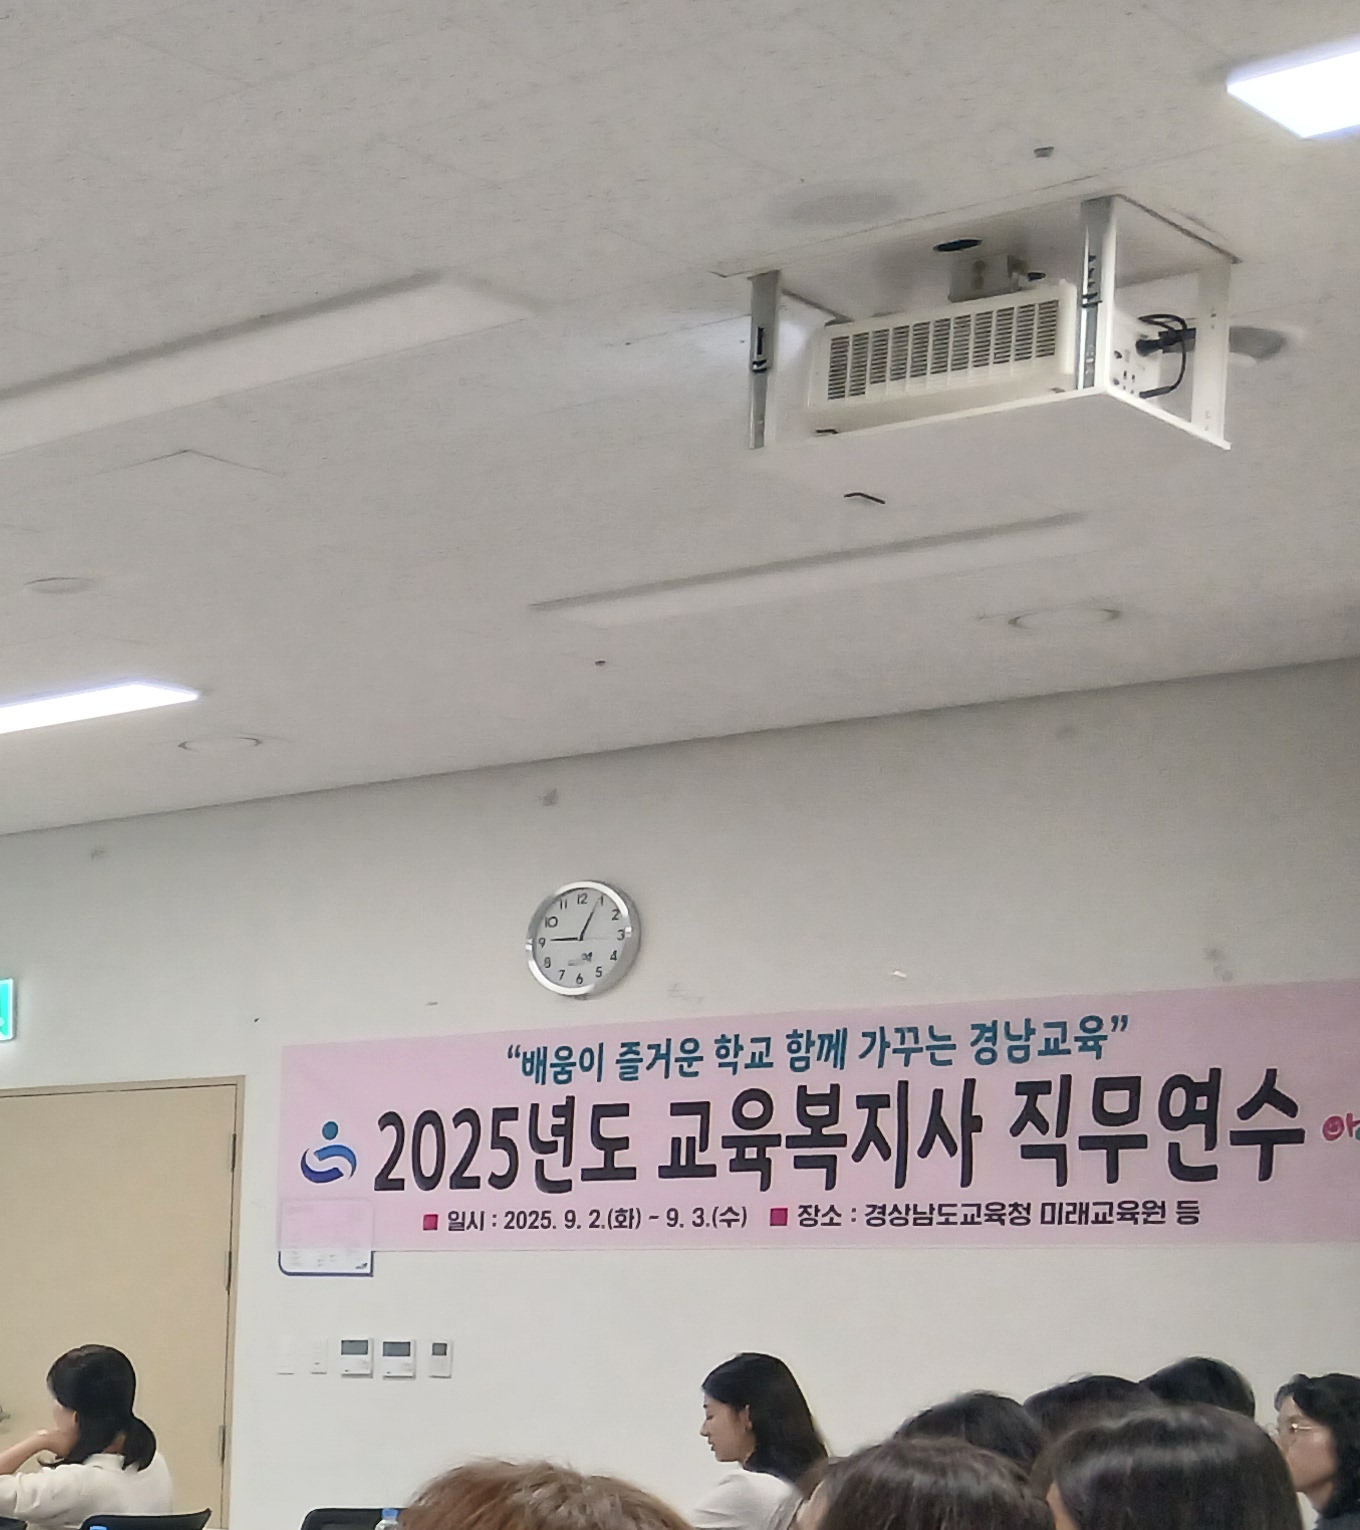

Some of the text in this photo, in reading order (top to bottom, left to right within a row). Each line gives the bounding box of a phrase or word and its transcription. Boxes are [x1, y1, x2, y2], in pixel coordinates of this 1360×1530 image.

[560, 899, 568, 910] 11
[577, 893, 588, 905] 12
[611, 909, 620, 921] 2
[544, 916, 559, 928] 10
[617, 929, 626, 941] 3
[538, 937, 546, 948] 9
[610, 950, 618, 961] 4
[544, 956, 552, 969] 8
[558, 969, 566, 981] 7
[595, 966, 603, 978] 5
[575, 973, 584, 985] 6
[615, 1037, 704, 1082] 즐거운
[714, 1033, 774, 1076] 학교
[785, 1028, 848, 1073] 함께
[858, 1024, 957, 1069] 가꾸는
[373, 1067, 1306, 1195] 2025년도 교육복지사 직무연수
[447, 1210, 485, 1232] 일시
[503, 1210, 557, 1230] 2025.
[564, 1209, 582, 1230] 9.
[588, 1207, 642, 1231] 2.(화)
[666, 1207, 684, 1229] 9.
[691, 1206, 748, 1229] 3.(수)
[797, 1204, 842, 1228] 장소
[864, 1201, 1032, 1228] 경상남도교육청
[1040, 1199, 1166, 1226] 미래교육원
[1175, 1200, 1201, 1226] 등
